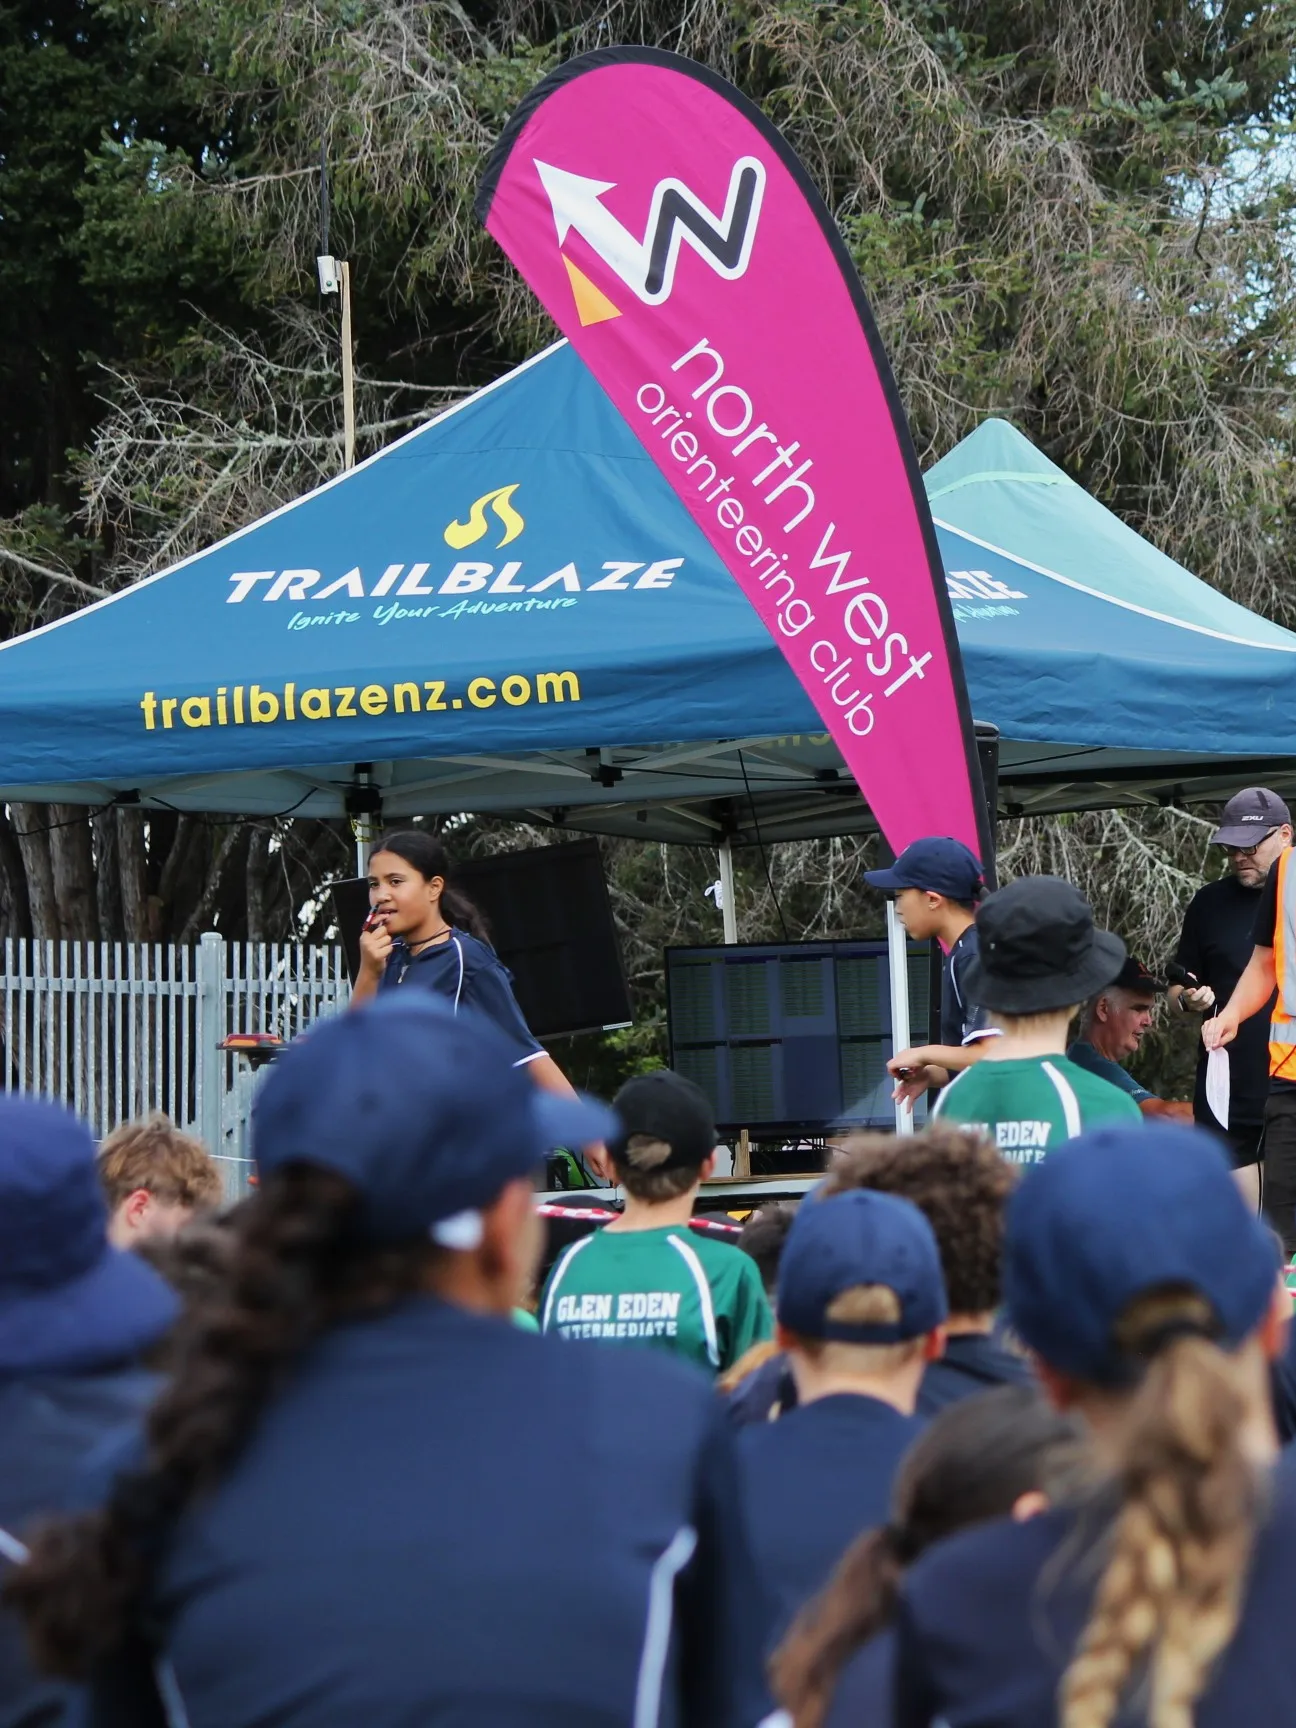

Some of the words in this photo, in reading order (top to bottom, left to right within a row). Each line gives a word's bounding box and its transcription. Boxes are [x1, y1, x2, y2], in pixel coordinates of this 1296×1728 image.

[671, 338, 815, 533] north
[809, 522, 933, 698] west
[226, 557, 685, 604] TRAILBLAZE
[637, 384, 815, 637] orienteering
[809, 640, 874, 736] club
[287, 610, 361, 632] Ignite
[372, 600, 440, 625] Your
[436, 594, 579, 620] Adventure
[141, 671, 580, 728] trailblazenz.com
[996, 1120, 1052, 1148] EDEN
[556, 1294, 613, 1323] GLEN
[617, 1291, 682, 1321] EDEN
